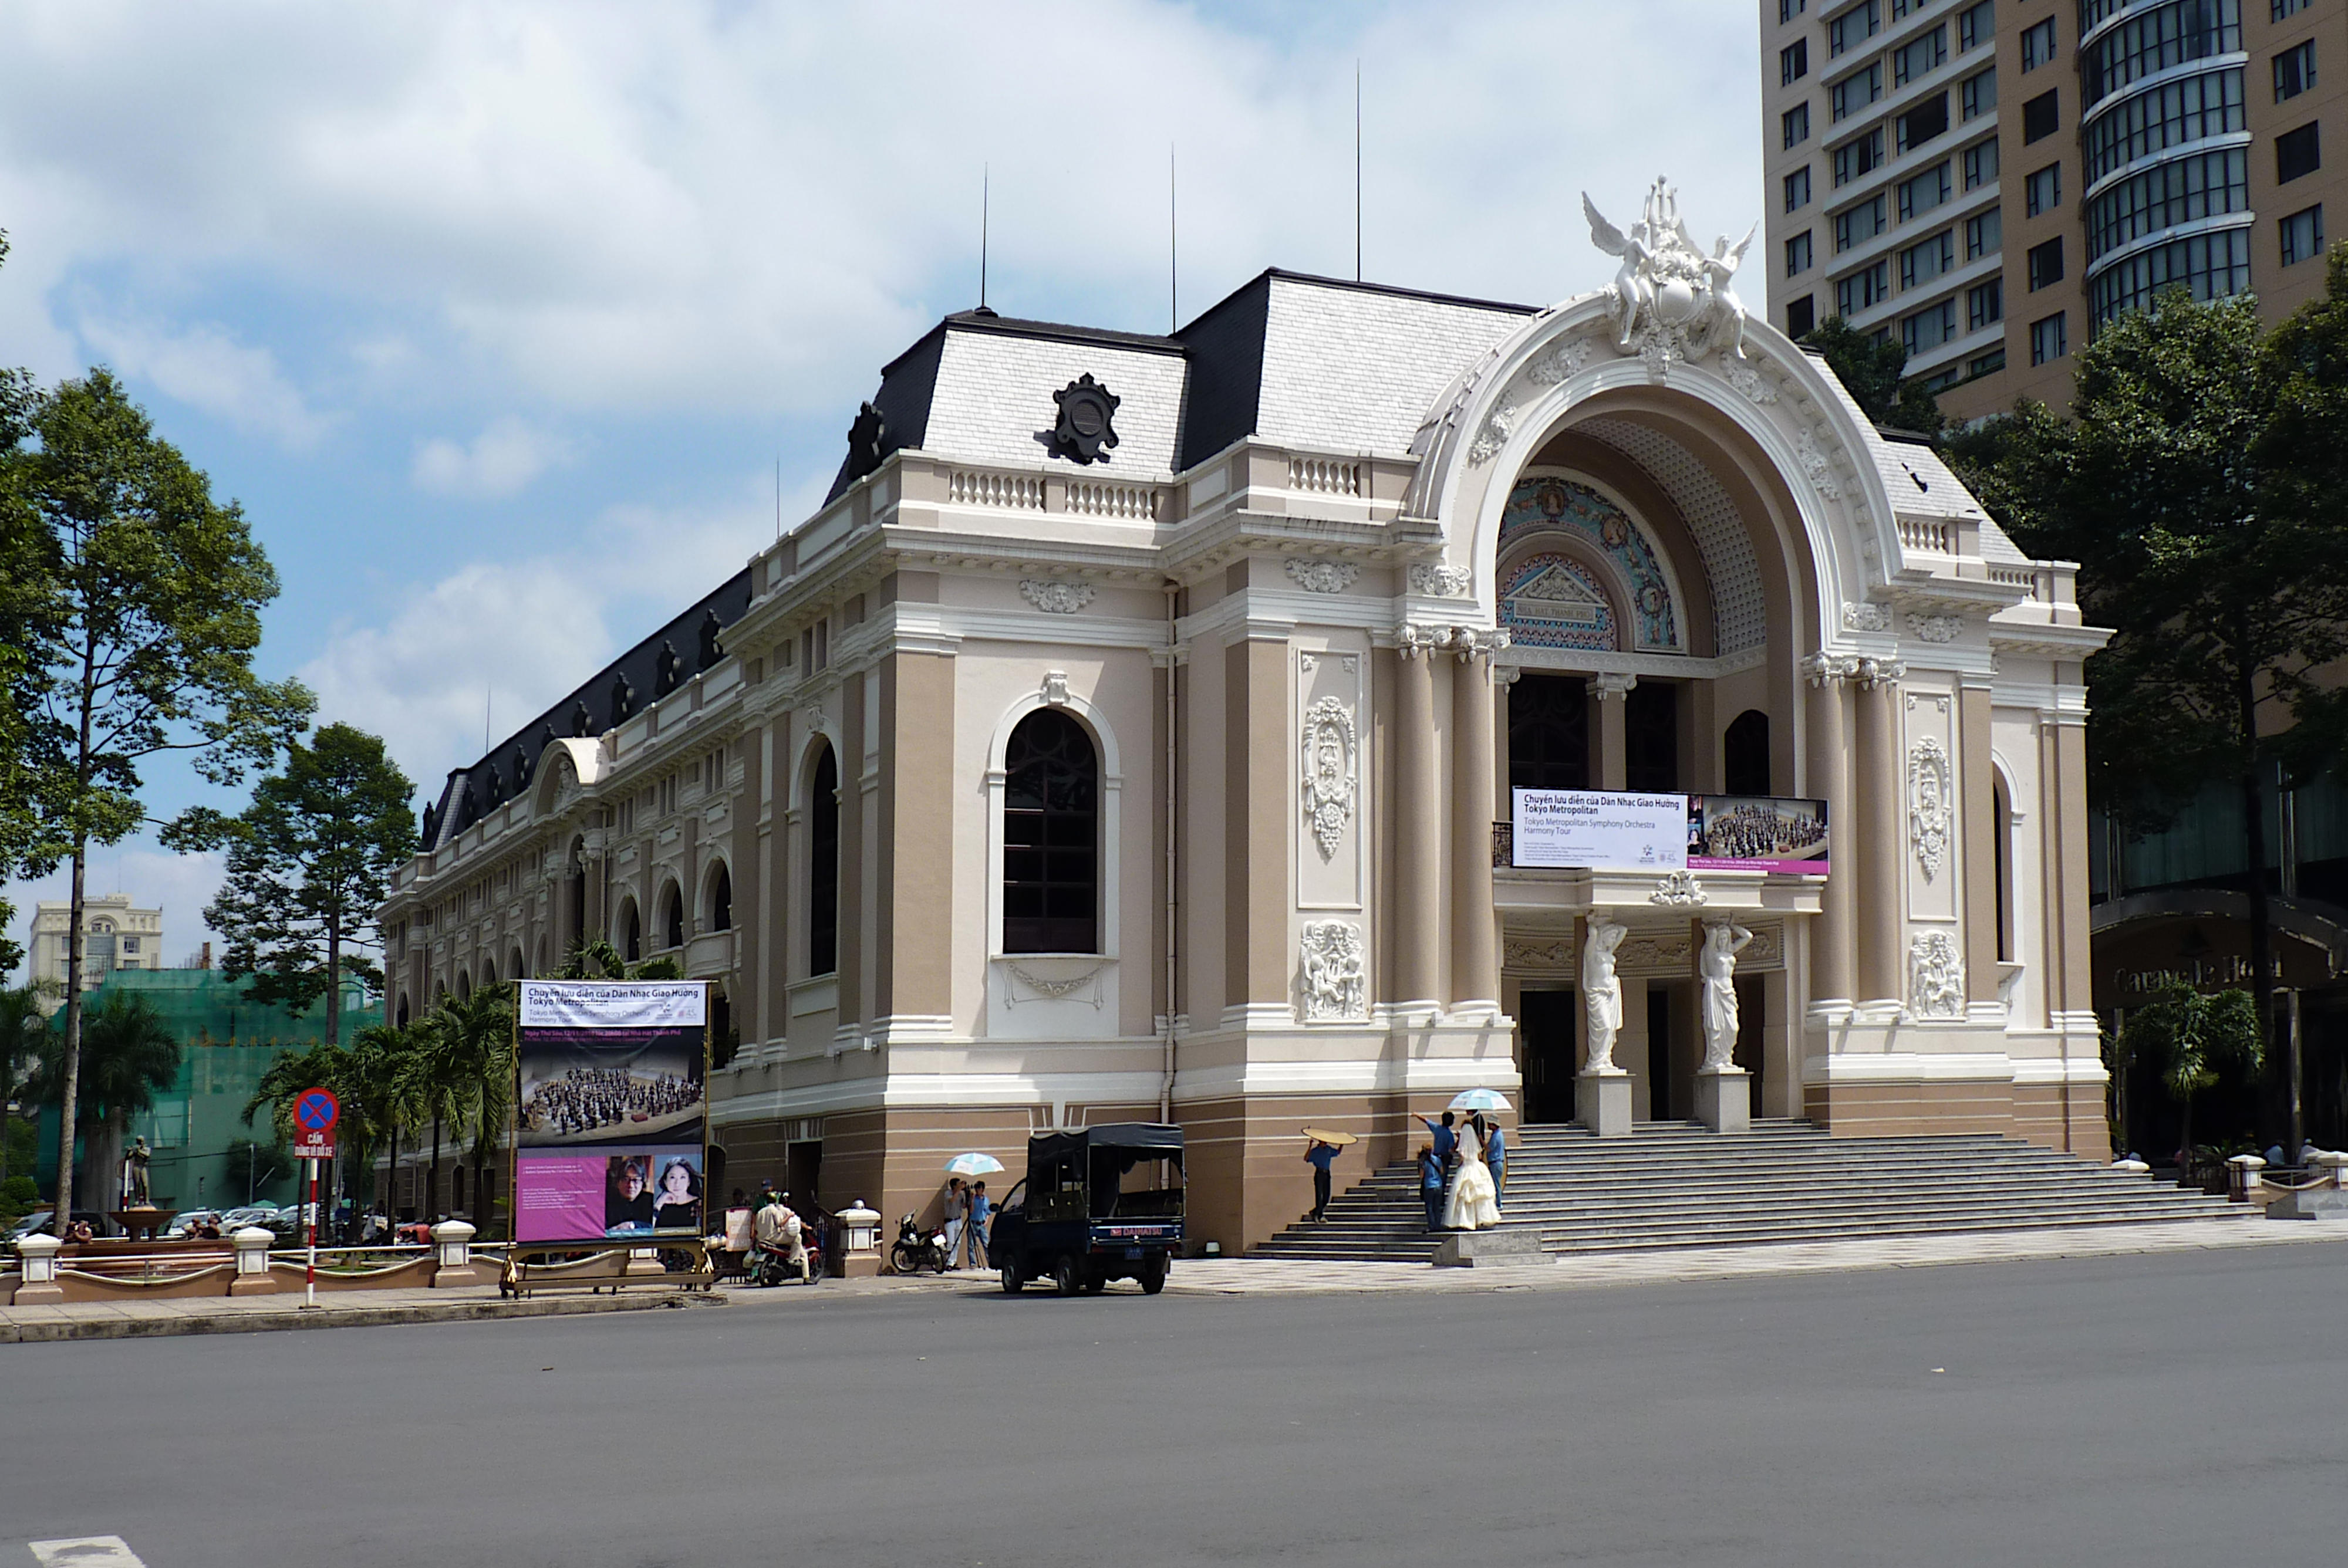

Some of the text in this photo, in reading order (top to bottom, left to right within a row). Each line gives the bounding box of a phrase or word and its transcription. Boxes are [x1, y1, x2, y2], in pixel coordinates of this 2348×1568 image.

[1617, 798, 1635, 809] Nhạc
[1637, 798, 1654, 807] Giao
[1525, 804, 1598, 815] Tokyo Metropolitan
[1524, 817, 1655, 829] Tokyo Metropolitan Symphony Orchestra
[1524, 826, 1571, 836] Harmony Tour
[652, 989, 670, 998] Giao
[529, 997, 609, 1008] Tokyo Metropolitan
[1123, 1228, 1162, 1236] DAIHATSU
